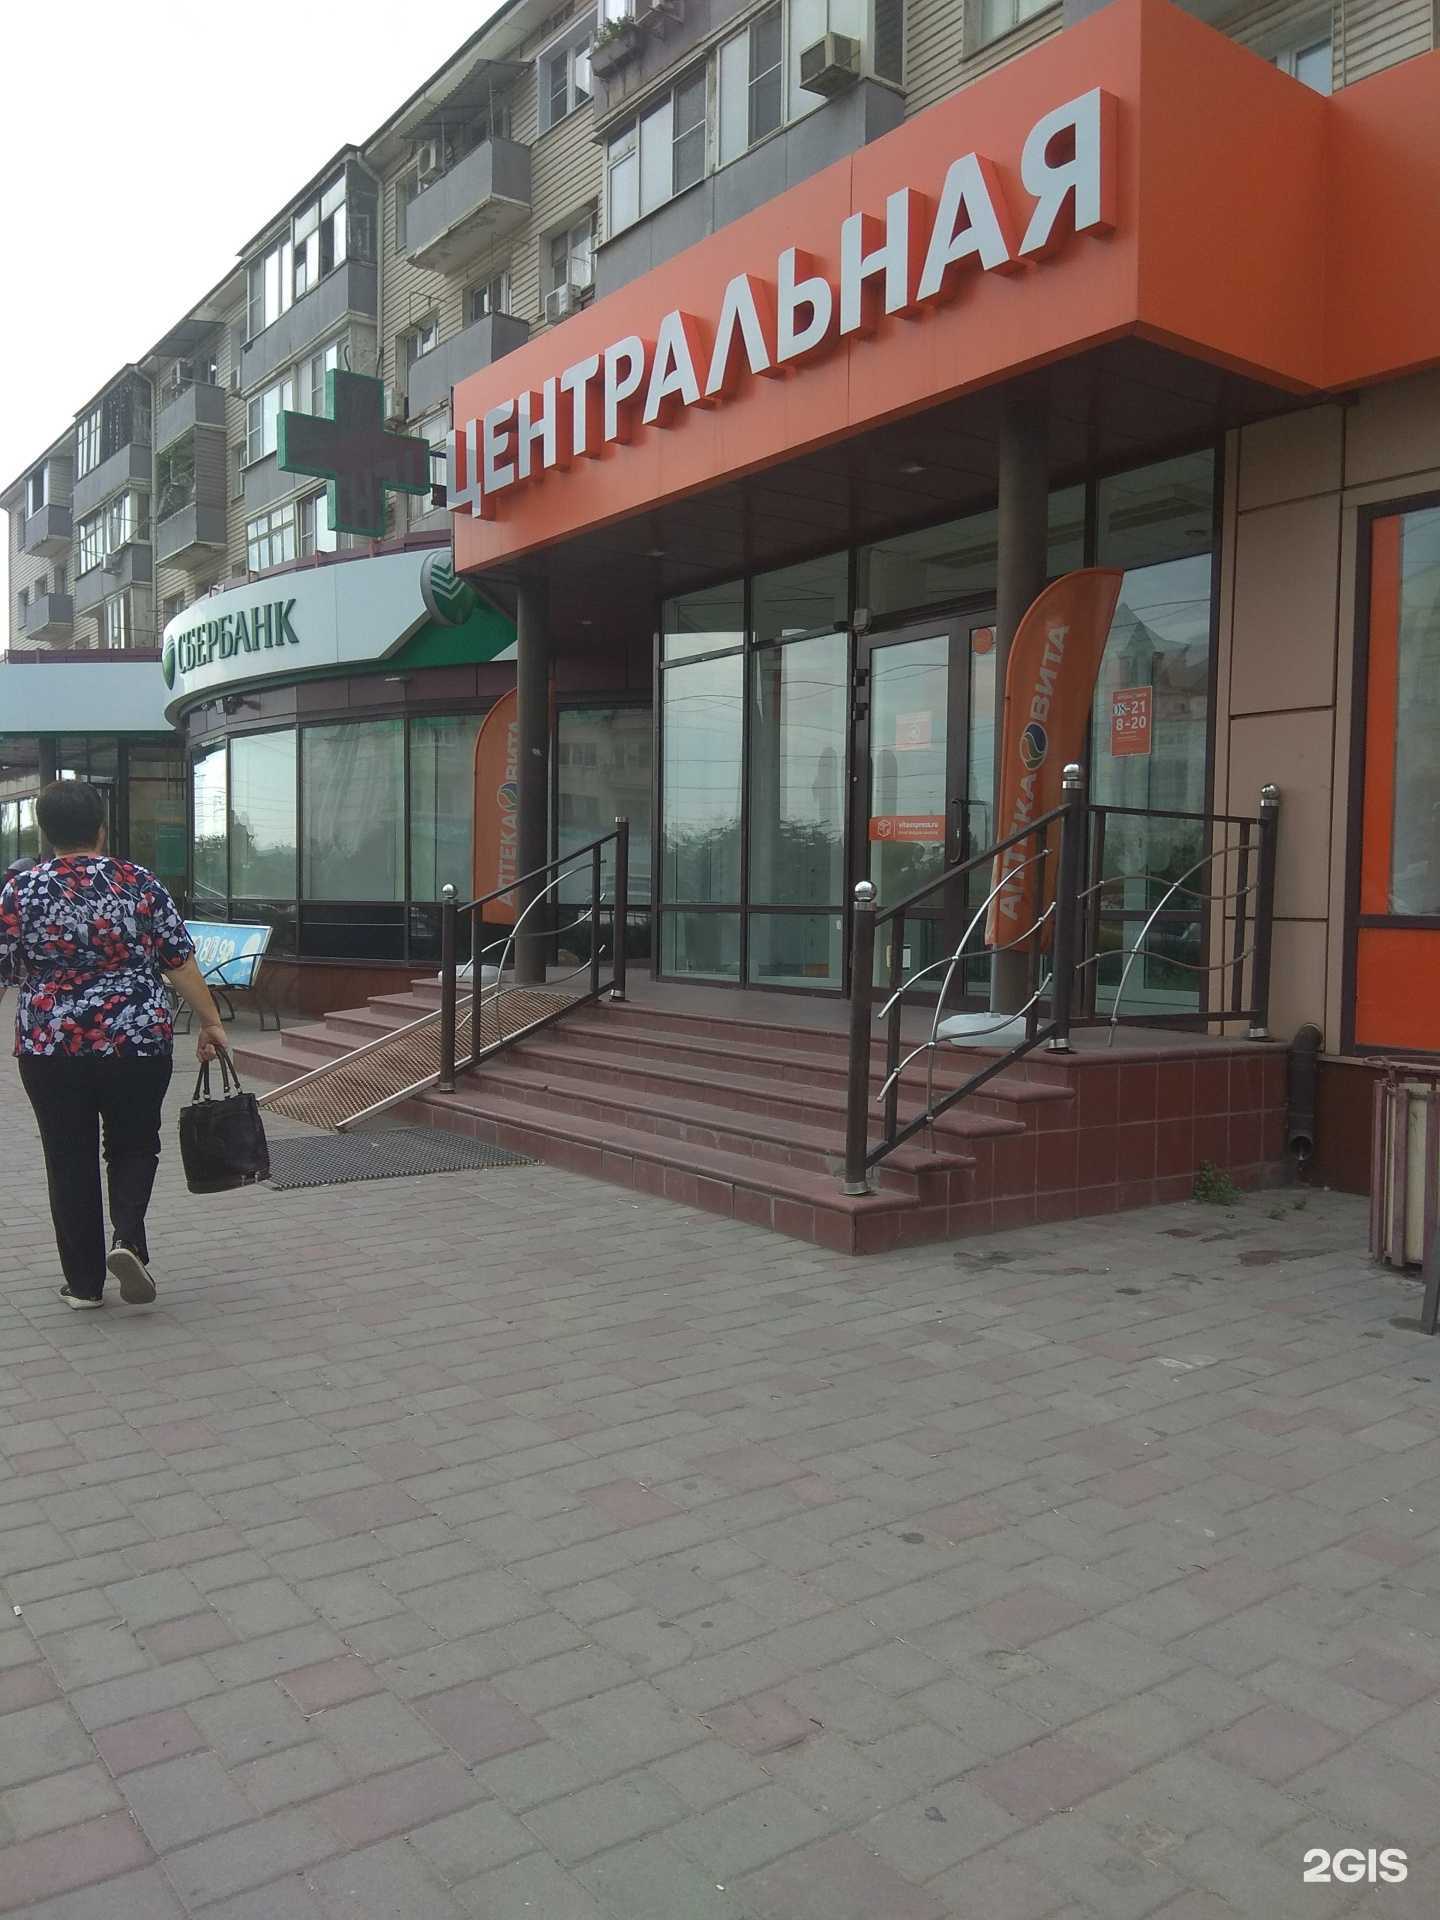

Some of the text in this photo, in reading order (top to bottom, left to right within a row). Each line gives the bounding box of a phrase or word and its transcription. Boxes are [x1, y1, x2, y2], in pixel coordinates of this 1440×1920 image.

[446, 86, 1102, 517] ЦЕНТРАЛЬНАЯ
[177, 598, 300, 674] СБЕРБАНК
[1031, 623, 1070, 722] ВИТА
[1116, 716, 1147, 731] 8-20
